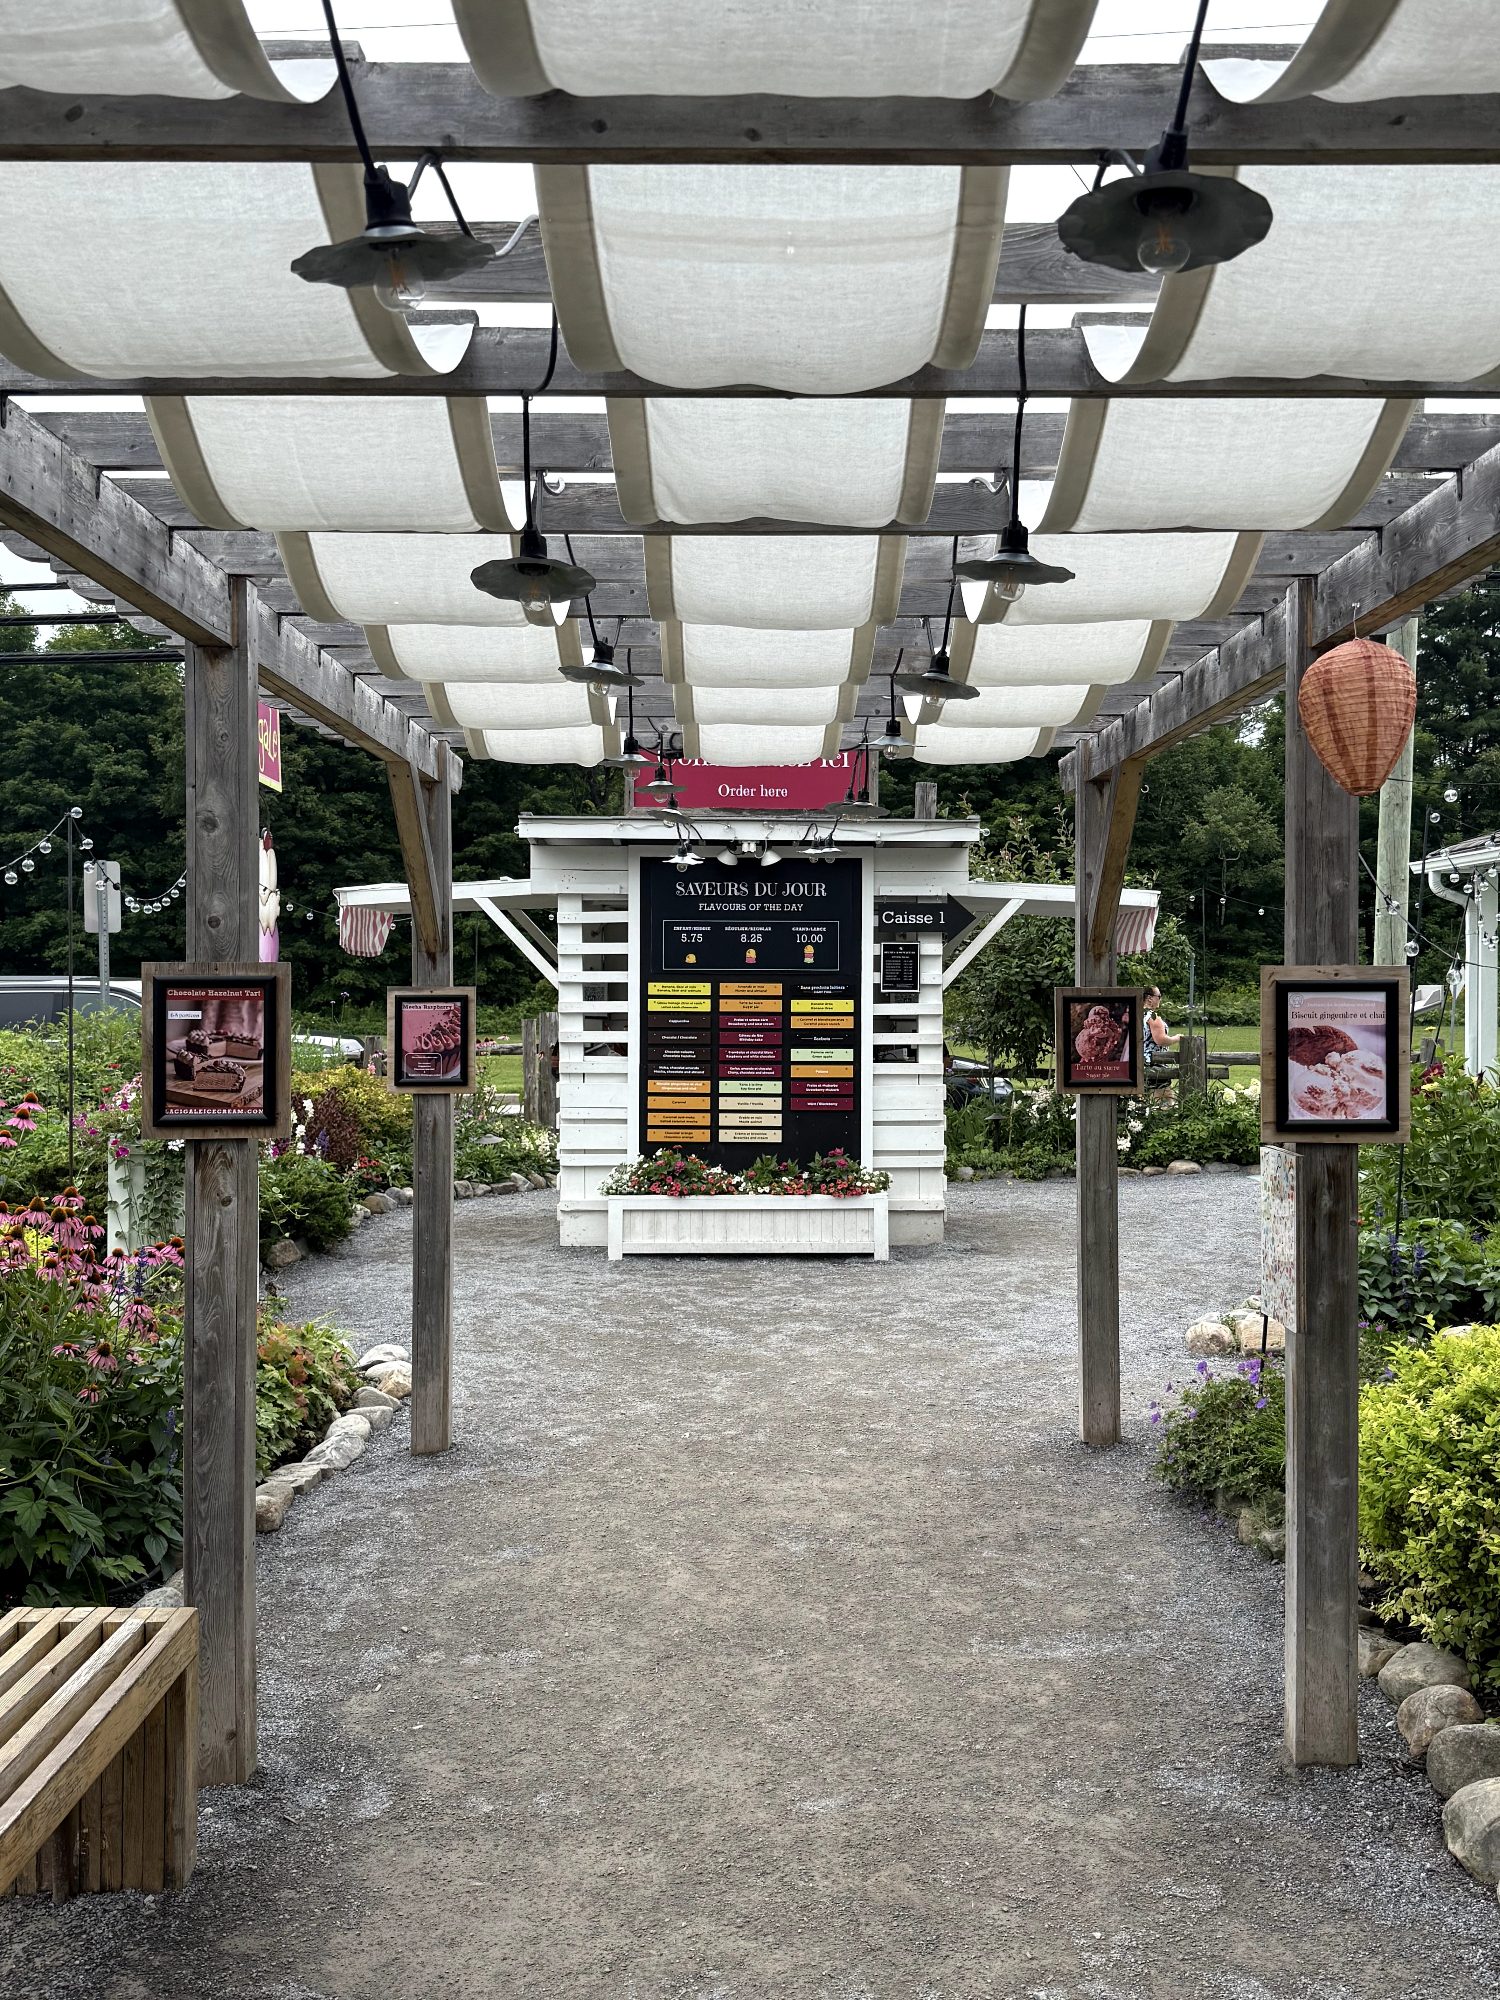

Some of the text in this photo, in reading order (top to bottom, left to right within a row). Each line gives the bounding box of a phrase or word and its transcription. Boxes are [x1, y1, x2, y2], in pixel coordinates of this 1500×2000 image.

[718, 784, 788, 797] Order here
[675, 882, 826, 897] SAVEURS DU JOUR
[882, 912, 945, 924] Caisse 1
[681, 934, 703, 943] 5.75
[740, 934, 763, 943] 8.25
[796, 934, 823, 943] 10.00
[1291, 1011, 1385, 1021] Biscuit gingembre et chai
